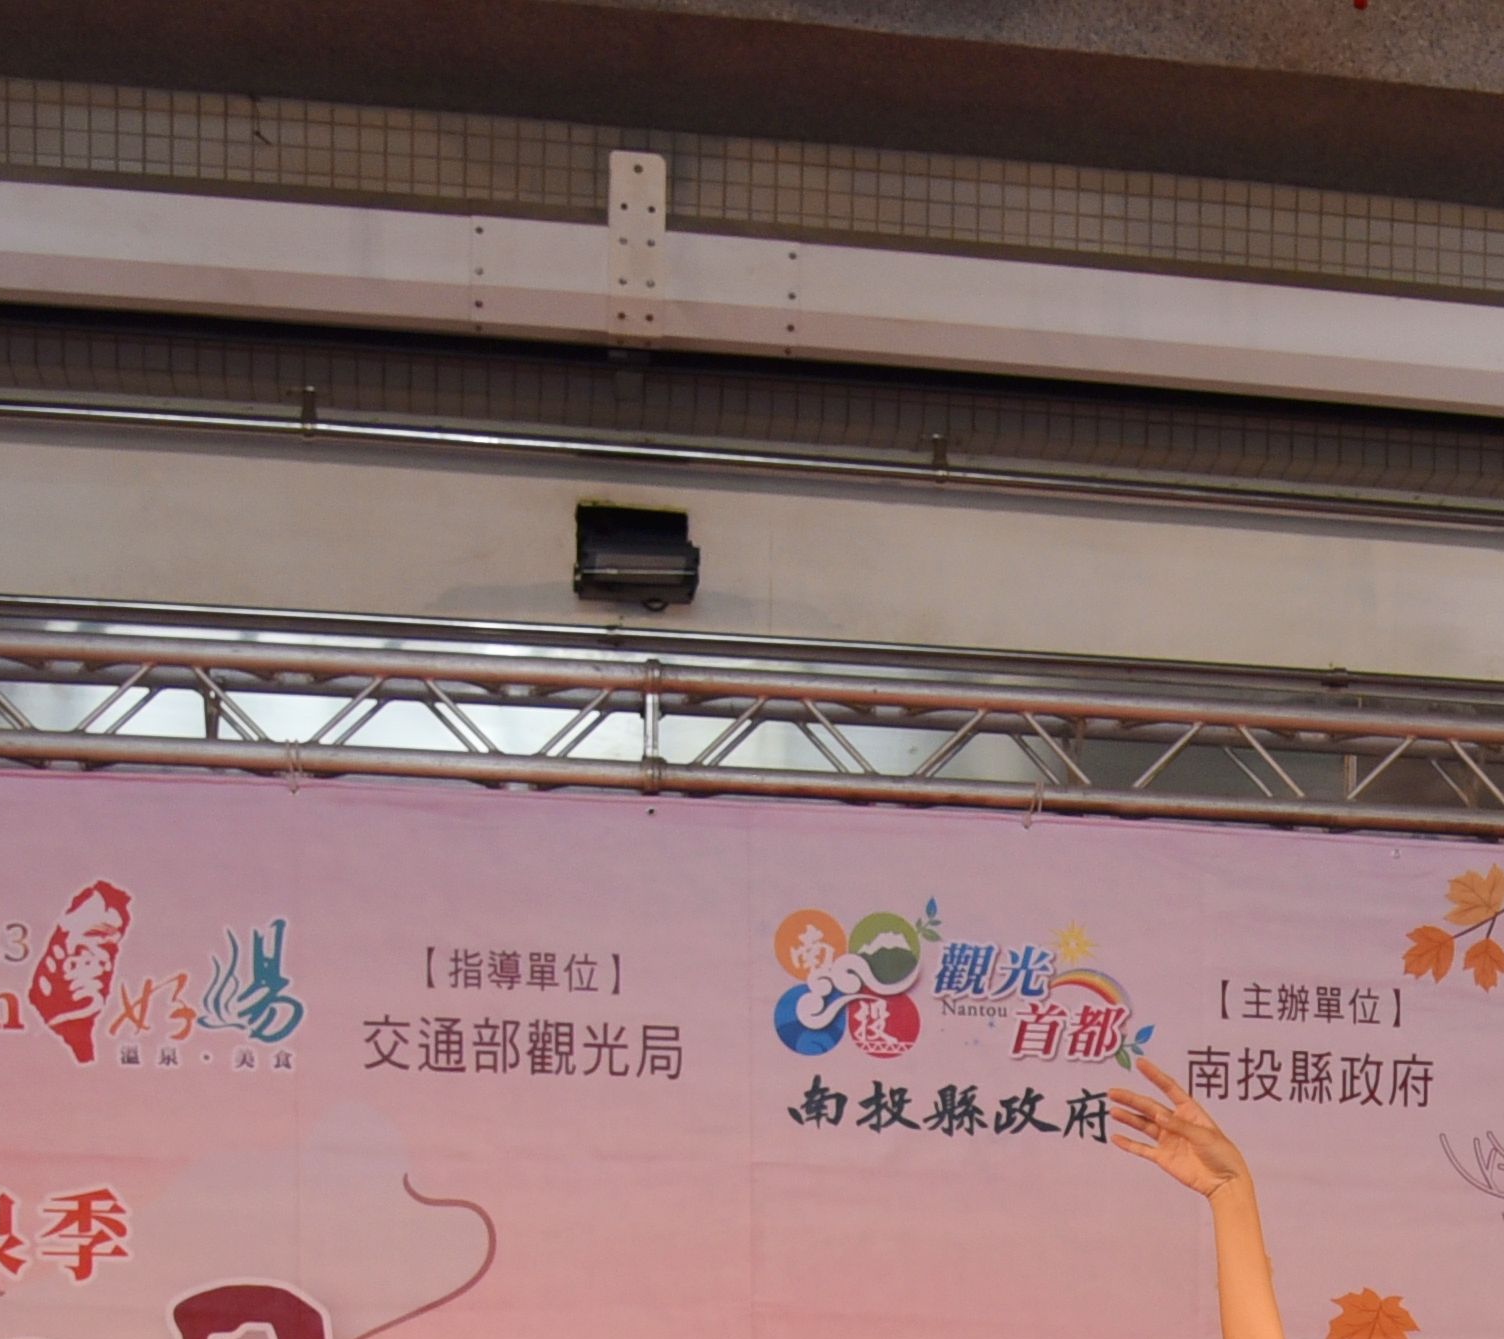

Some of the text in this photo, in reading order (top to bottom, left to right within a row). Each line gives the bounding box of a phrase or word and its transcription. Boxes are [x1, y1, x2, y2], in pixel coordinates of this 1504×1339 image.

[425, 947, 621, 995] 【指導單位】
[933, 941, 1056, 1000] 觀光
[942, 1000, 1008, 1019] Nantou
[1010, 1002, 1130, 1061] 首都
[1220, 979, 1402, 1028] 【主辦單位】
[362, 1014, 684, 1080] 交通部觀光局
[1187, 1045, 1434, 1108] 南投縣政府
[787, 1074, 1109, 1144] 南投縣政府
